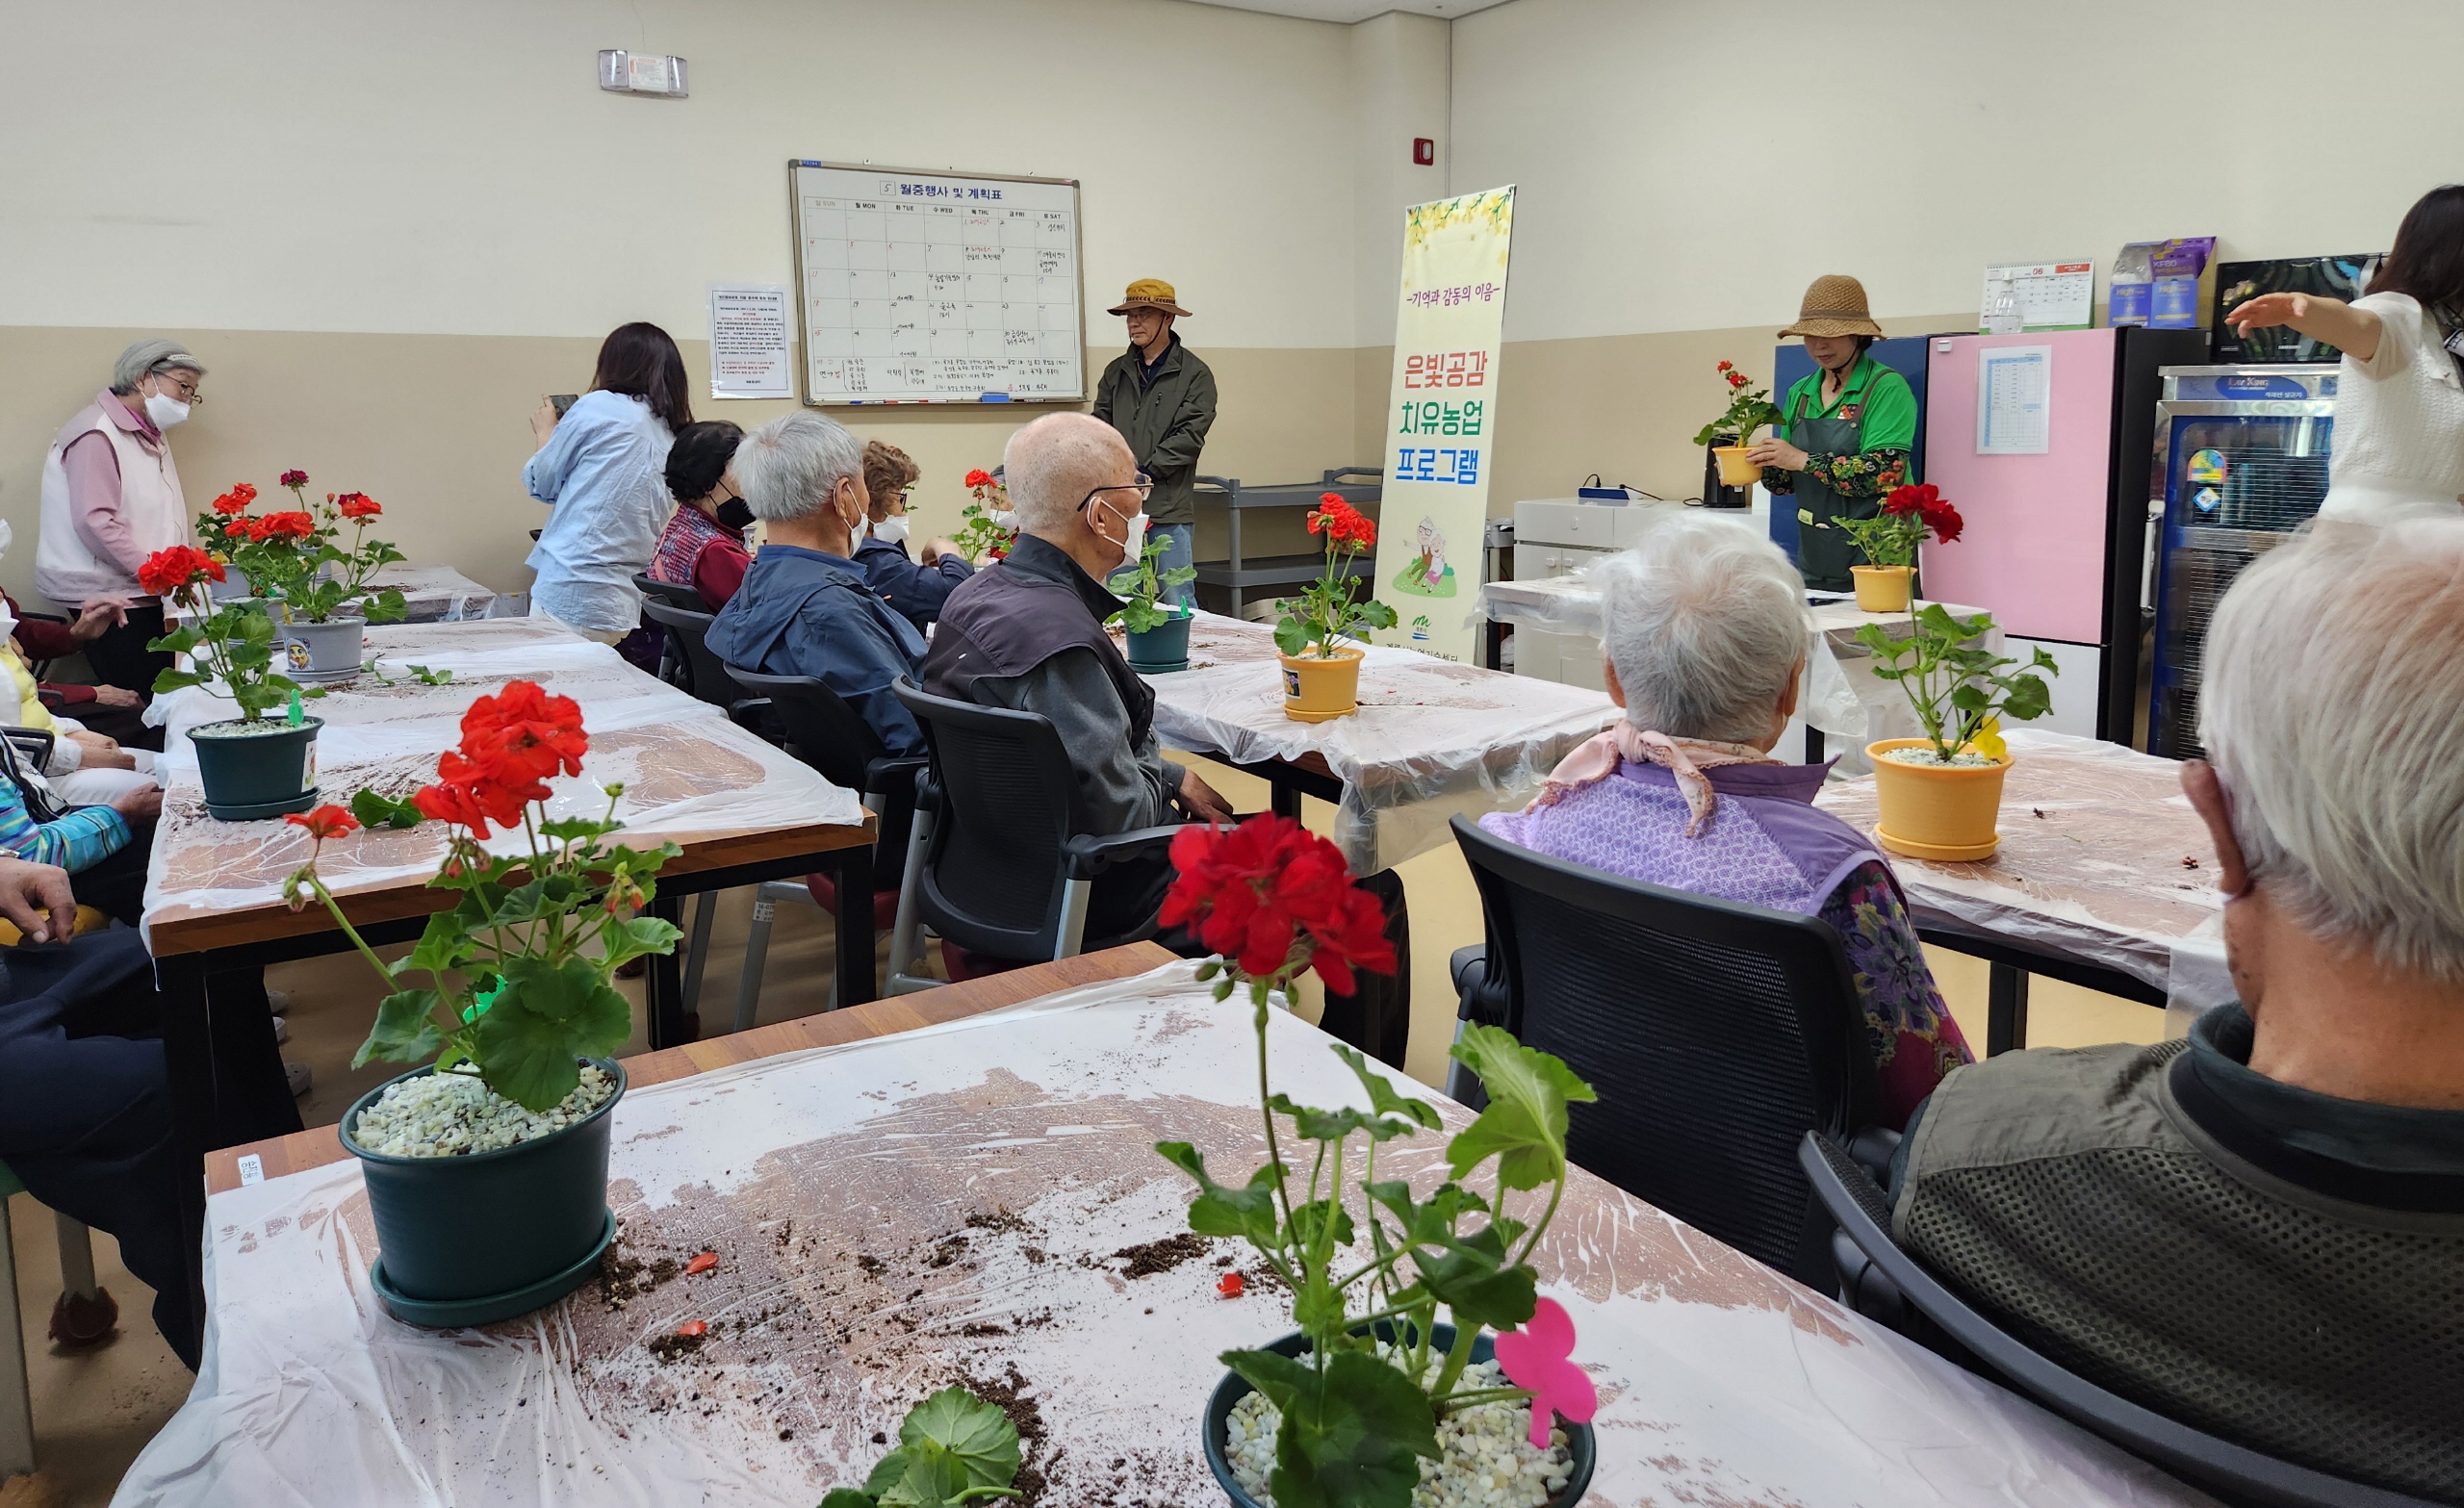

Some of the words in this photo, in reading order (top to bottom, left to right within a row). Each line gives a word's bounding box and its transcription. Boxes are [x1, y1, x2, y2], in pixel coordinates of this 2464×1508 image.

[885, 183, 892, 192] 5
[899, 183, 949, 197] 월중행사
[953, 188, 963, 198] 및
[967, 188, 1003, 200] 계획표
[1406, 289, 1441, 309] -기억과
[1442, 285, 1472, 307] 감동의
[1475, 282, 1501, 302] 이음-
[1404, 350, 1488, 390] 은빛공감
[1399, 399, 1483, 436] 치유농업
[1396, 447, 1479, 485] 프로그램
